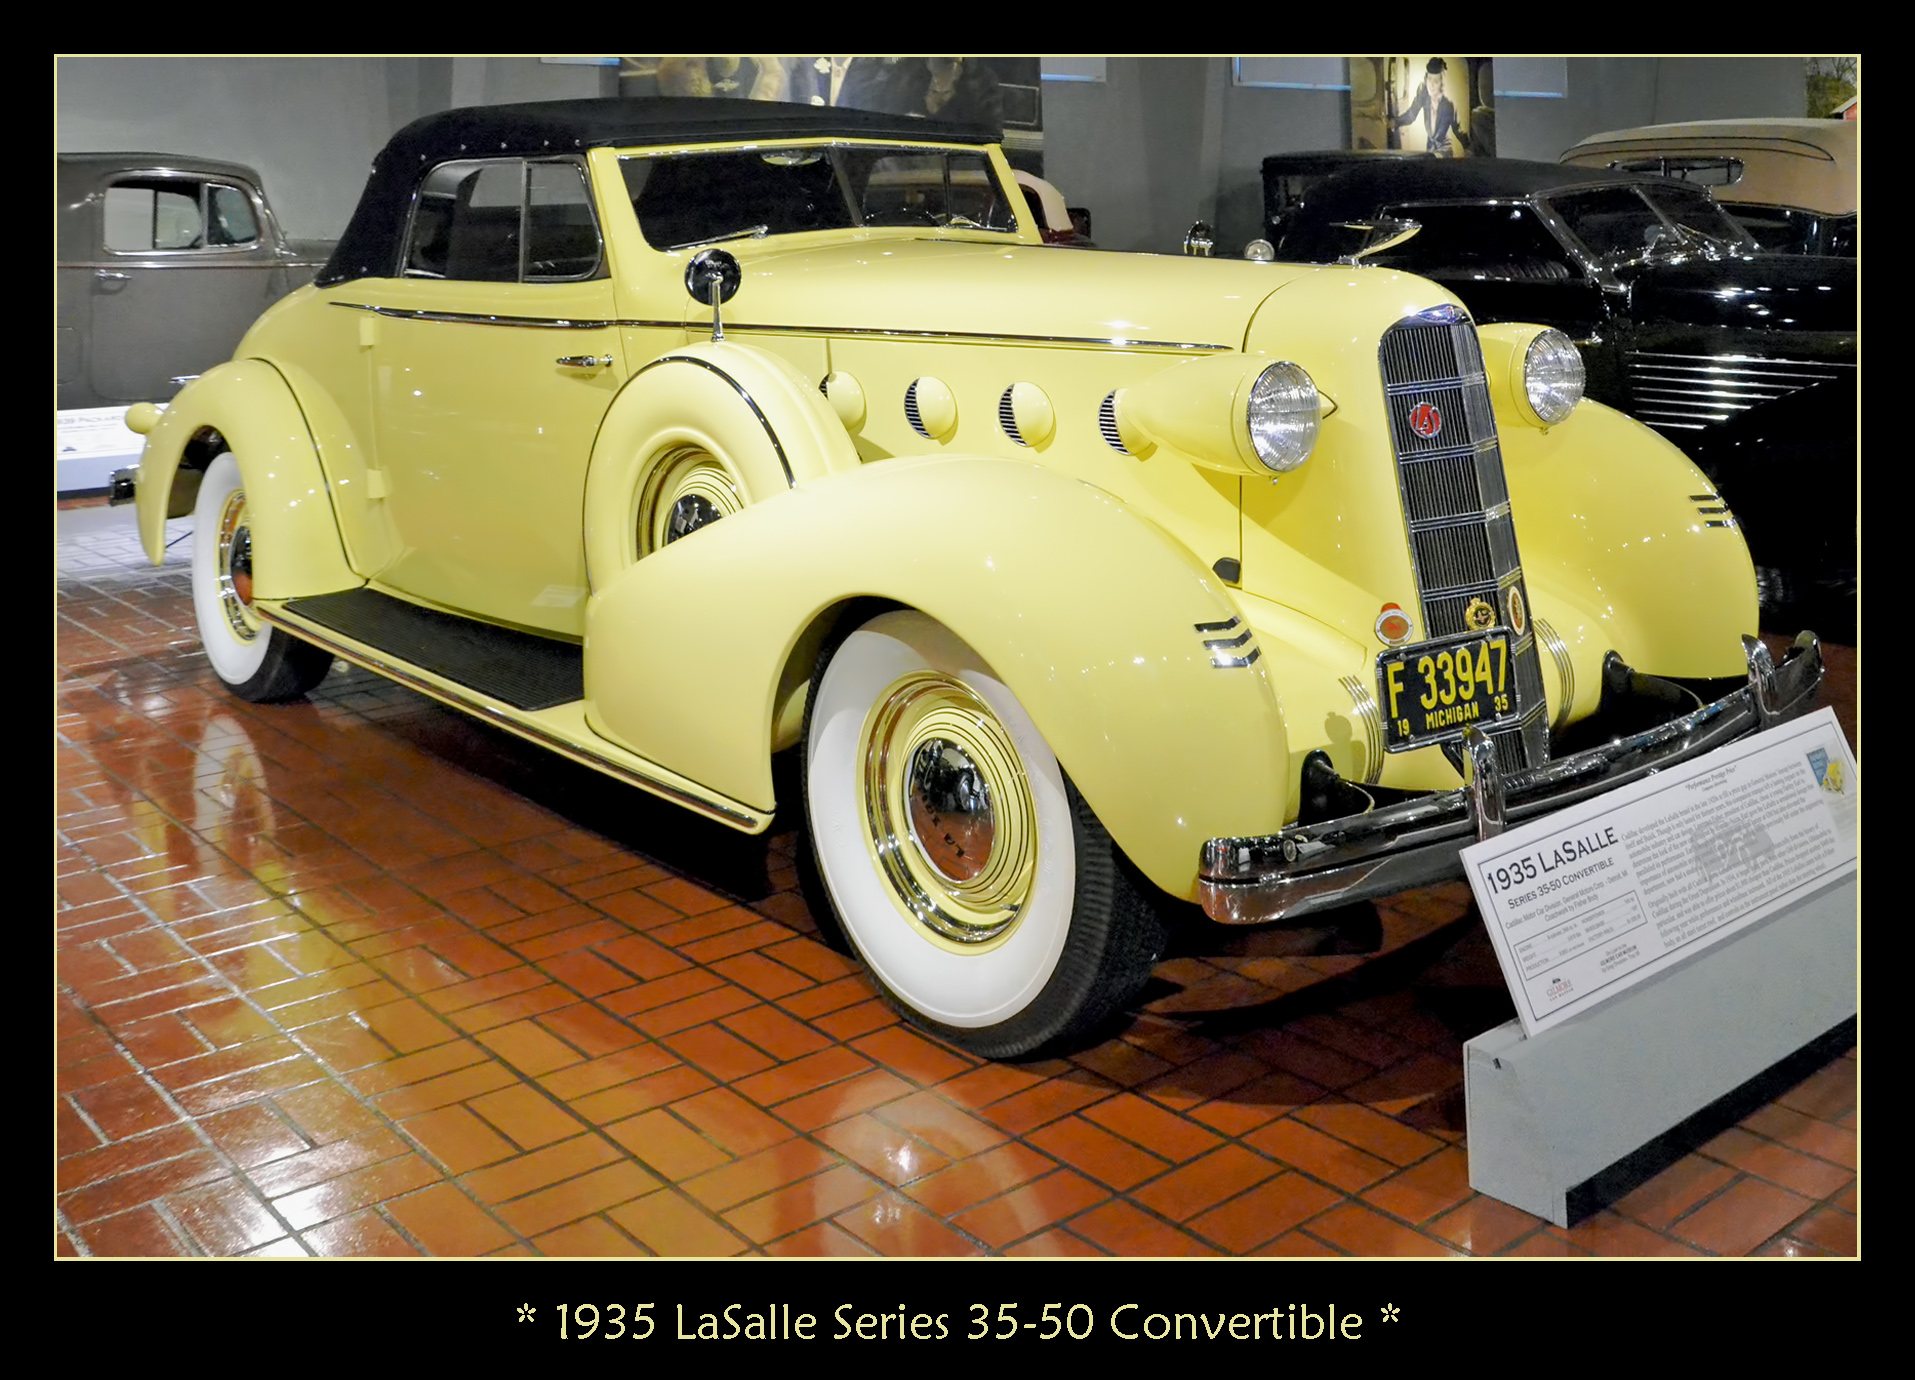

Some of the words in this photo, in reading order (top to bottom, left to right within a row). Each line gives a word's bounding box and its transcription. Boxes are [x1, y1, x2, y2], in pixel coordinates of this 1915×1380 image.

[1387, 662, 1404, 718] F
[1418, 639, 1507, 710] 33947
[1397, 719, 1410, 736] 19
[1425, 701, 1479, 730] MICHIGAN
[1494, 694, 1508, 712] 35
[1487, 856, 1538, 894] 1935
[1538, 878, 1562, 899] 35-50
